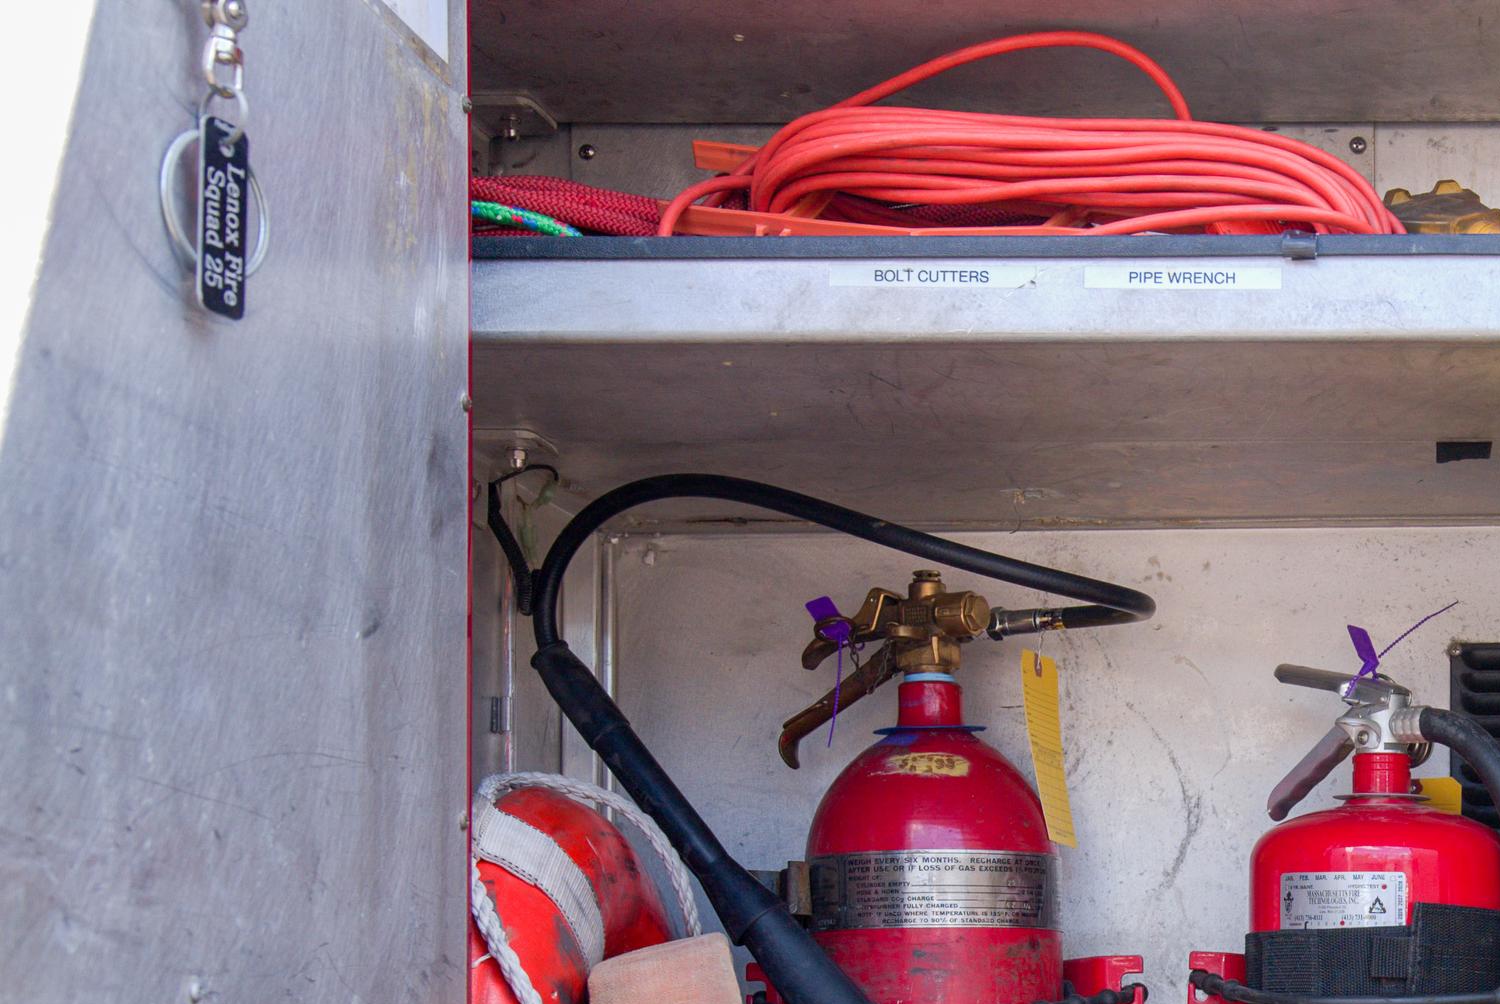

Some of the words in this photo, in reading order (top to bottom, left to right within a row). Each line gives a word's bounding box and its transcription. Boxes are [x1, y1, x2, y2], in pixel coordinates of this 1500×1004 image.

[204, 166, 226, 248] Squad
[225, 162, 246, 247] Lenox
[205, 253, 225, 290] 25
[223, 252, 244, 306] Fire
[874, 269, 914, 282] BOLT
[918, 270, 989, 283] CUTTERS
[1129, 271, 1163, 284] PIPE
[1168, 271, 1236, 284] WRENCH
[874, 865, 889, 873] USE
[970, 857, 1013, 865] RECHARGE
